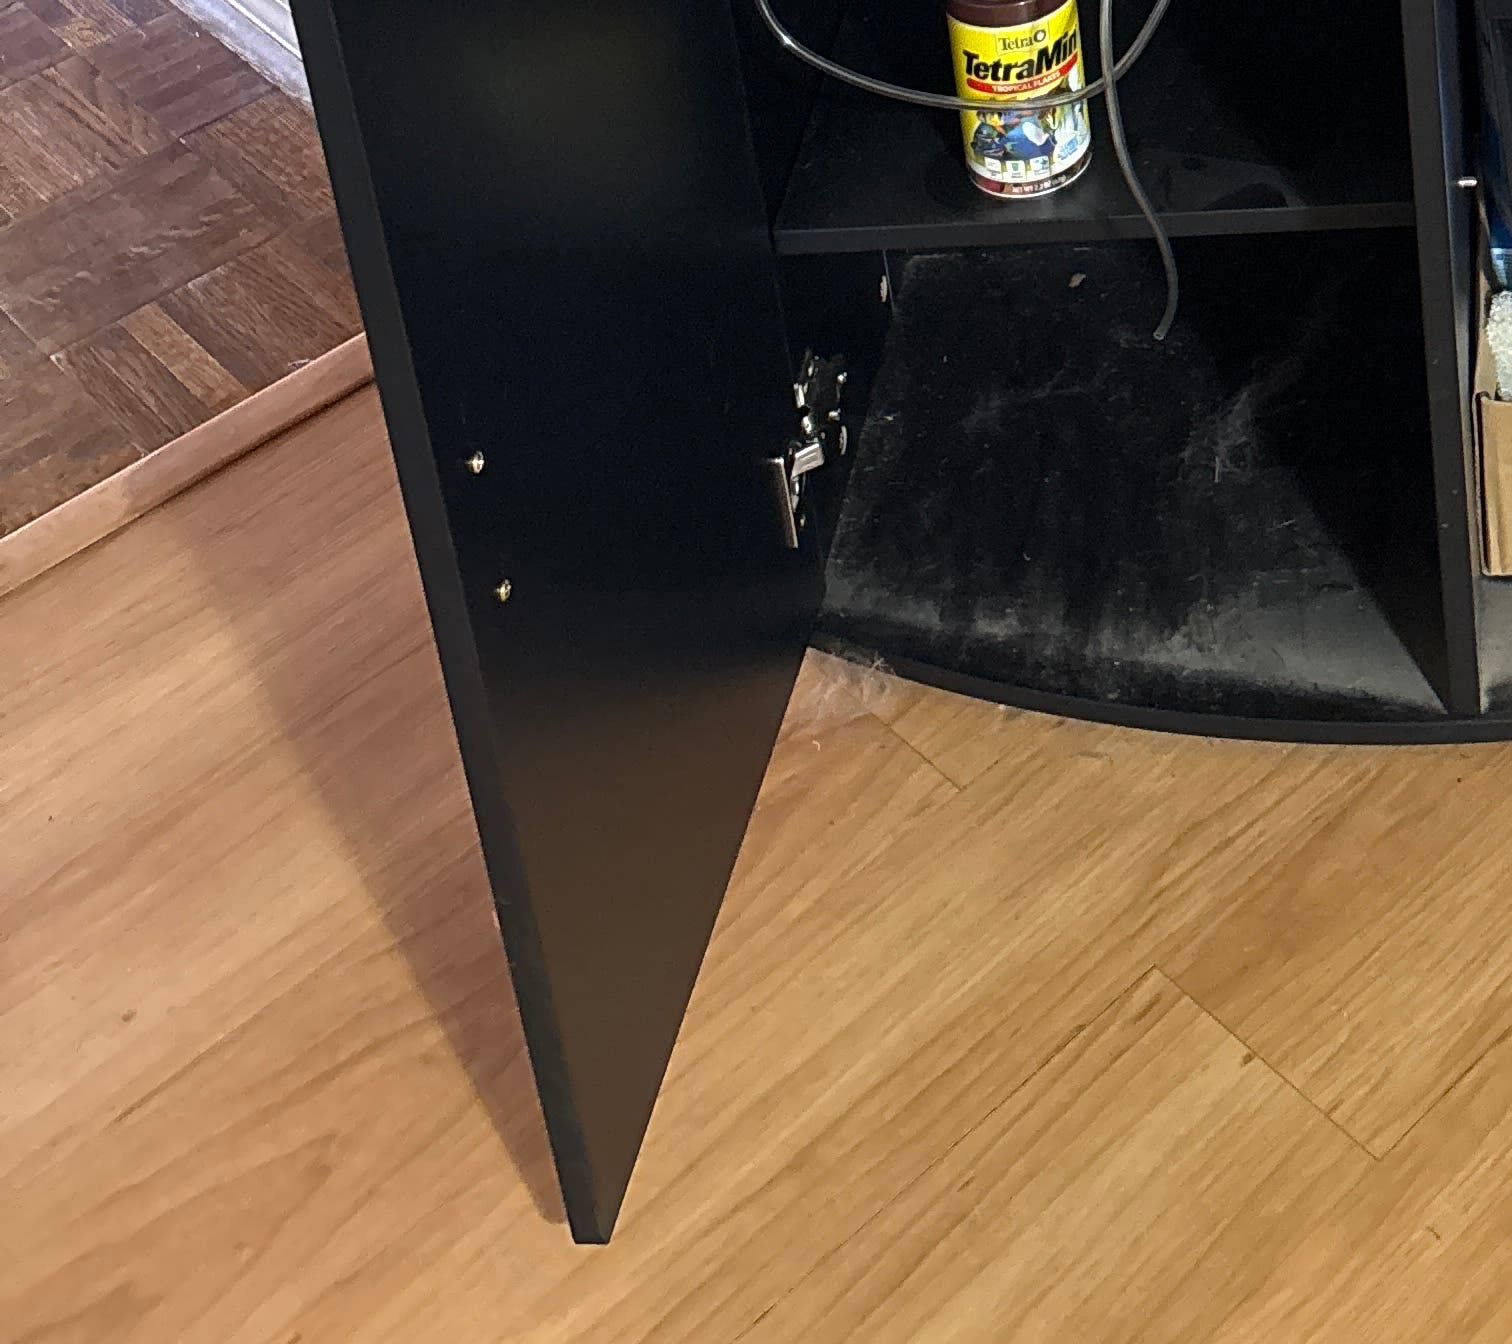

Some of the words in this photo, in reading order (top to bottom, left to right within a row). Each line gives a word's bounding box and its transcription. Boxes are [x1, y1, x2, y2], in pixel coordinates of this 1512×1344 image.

[962, 28, 1078, 82] TetraMin
[992, 80, 1033, 93] TROPICAL
[1033, 71, 1062, 88] FLAKES
